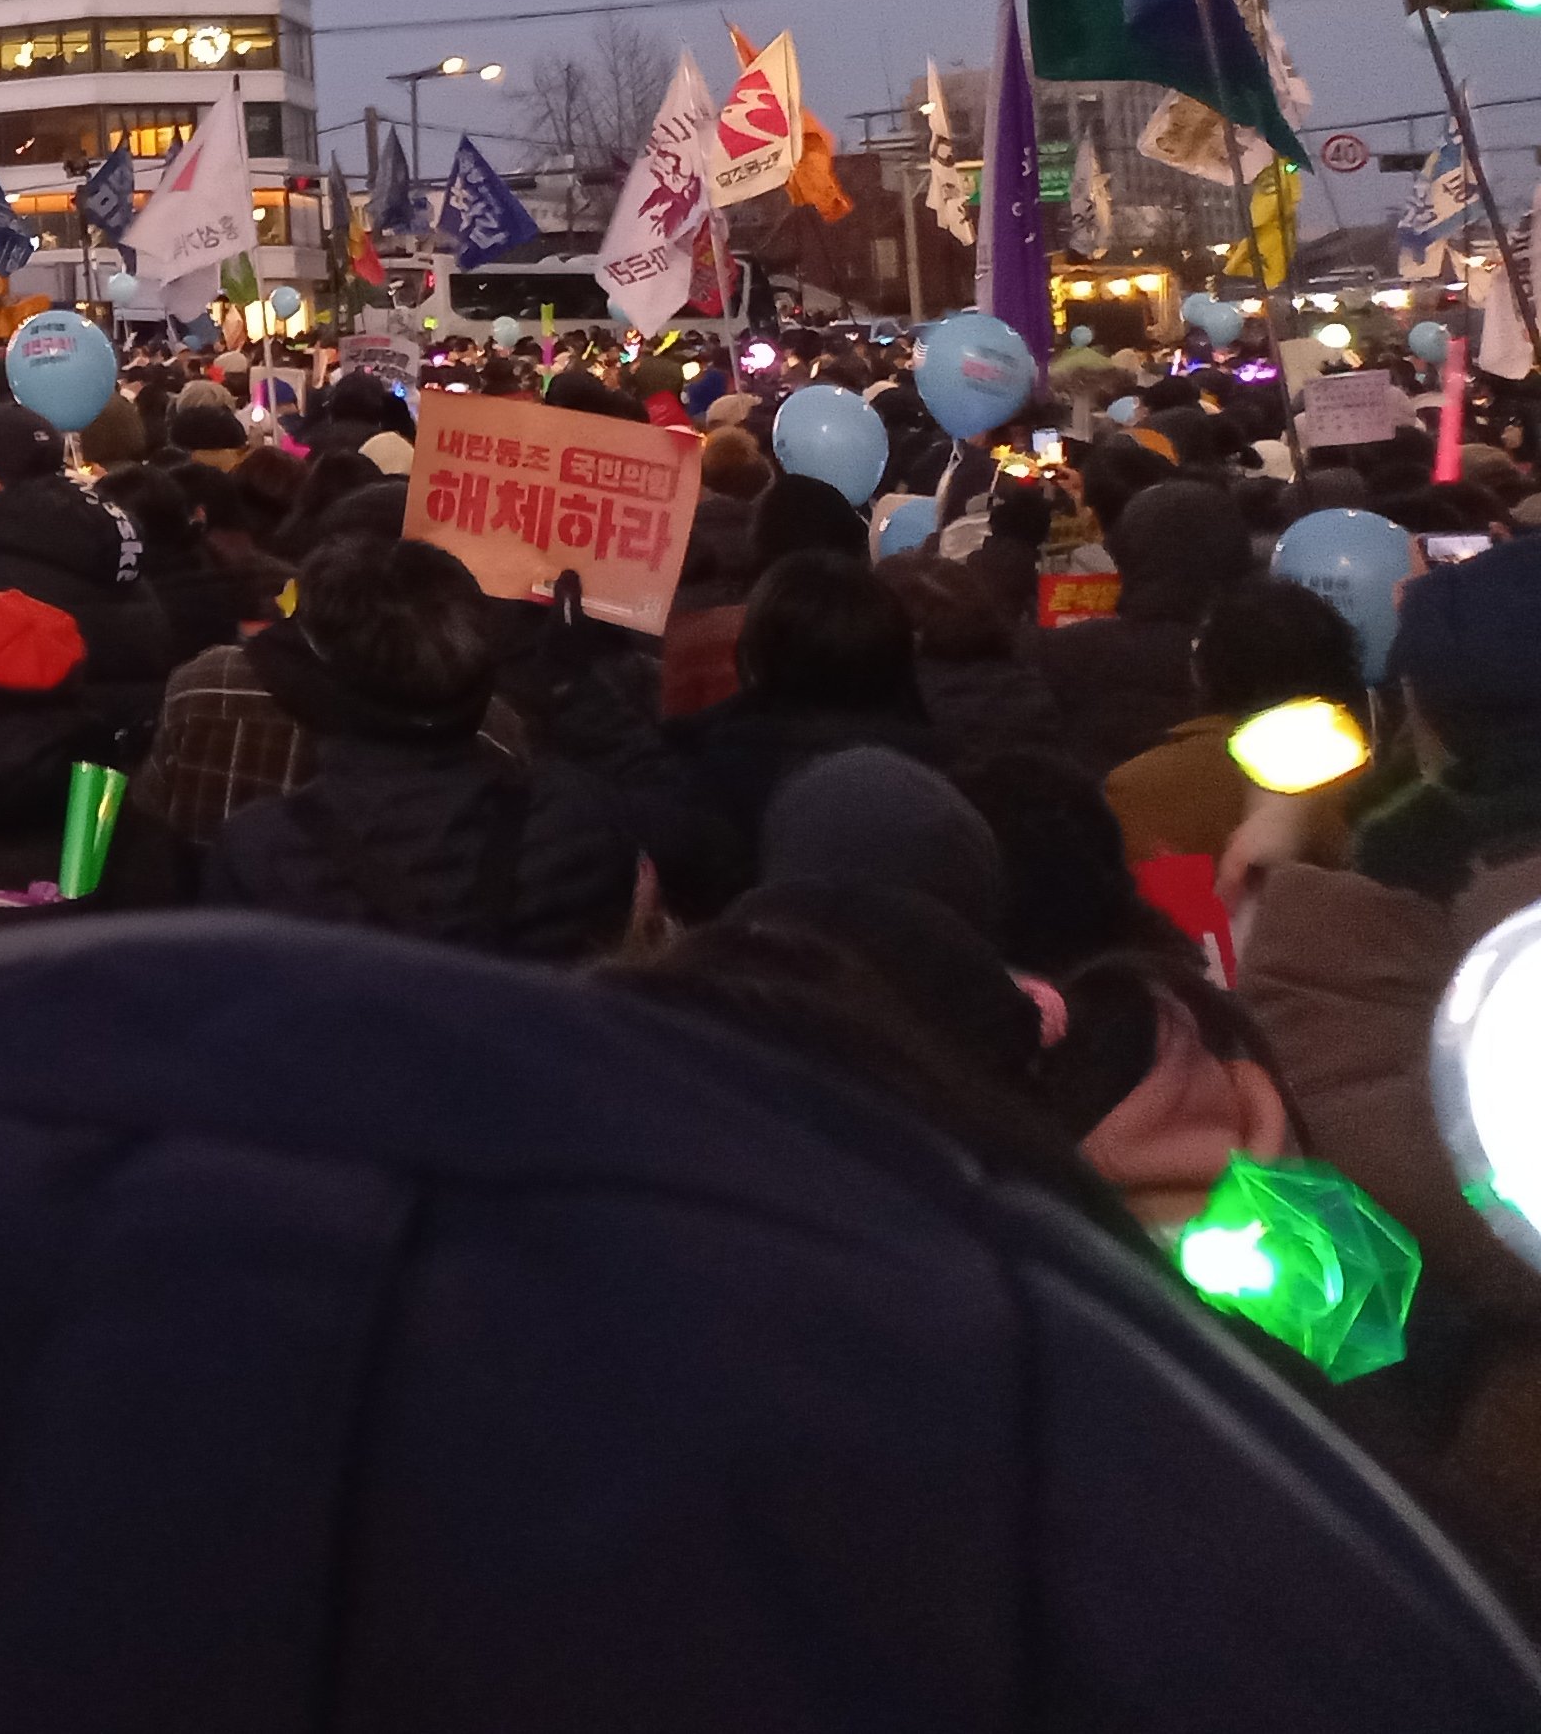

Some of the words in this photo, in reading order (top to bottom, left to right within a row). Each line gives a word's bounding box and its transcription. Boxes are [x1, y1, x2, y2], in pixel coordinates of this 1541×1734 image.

[1330, 142, 1358, 165] 40
[437, 428, 551, 471] 내란동조
[425, 469, 672, 572] 해체하라
